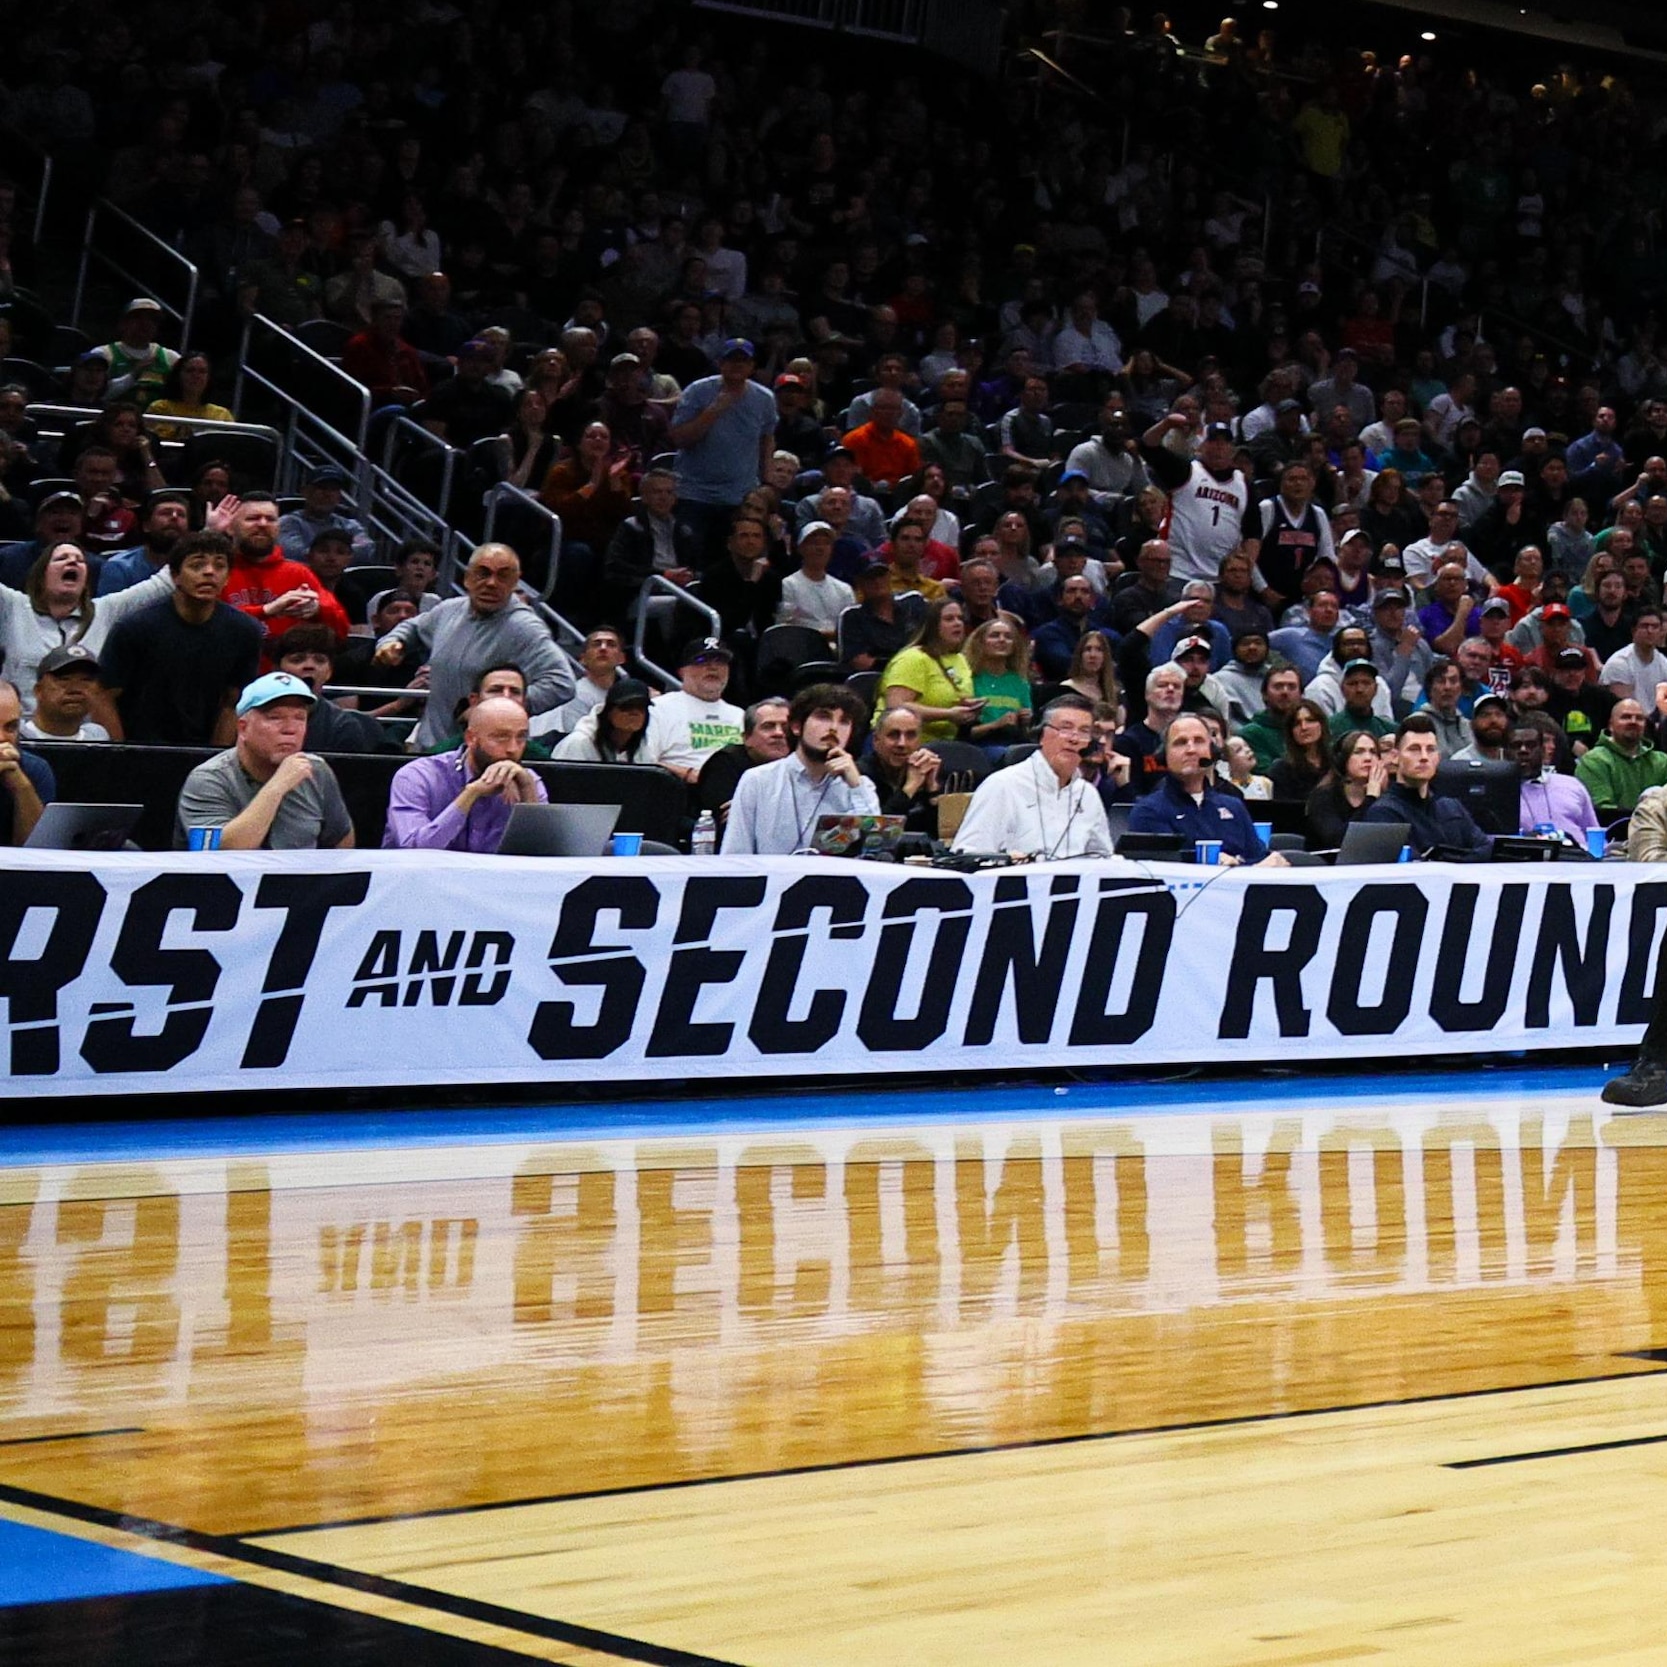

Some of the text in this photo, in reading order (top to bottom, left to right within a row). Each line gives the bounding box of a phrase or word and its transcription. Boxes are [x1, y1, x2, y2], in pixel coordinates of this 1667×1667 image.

[1195, 486, 1240, 510] ARIZONA
[1211, 505, 1220, 527] 1
[346, 928, 516, 1009] AND
[527, 875, 1178, 1062] SECOND
